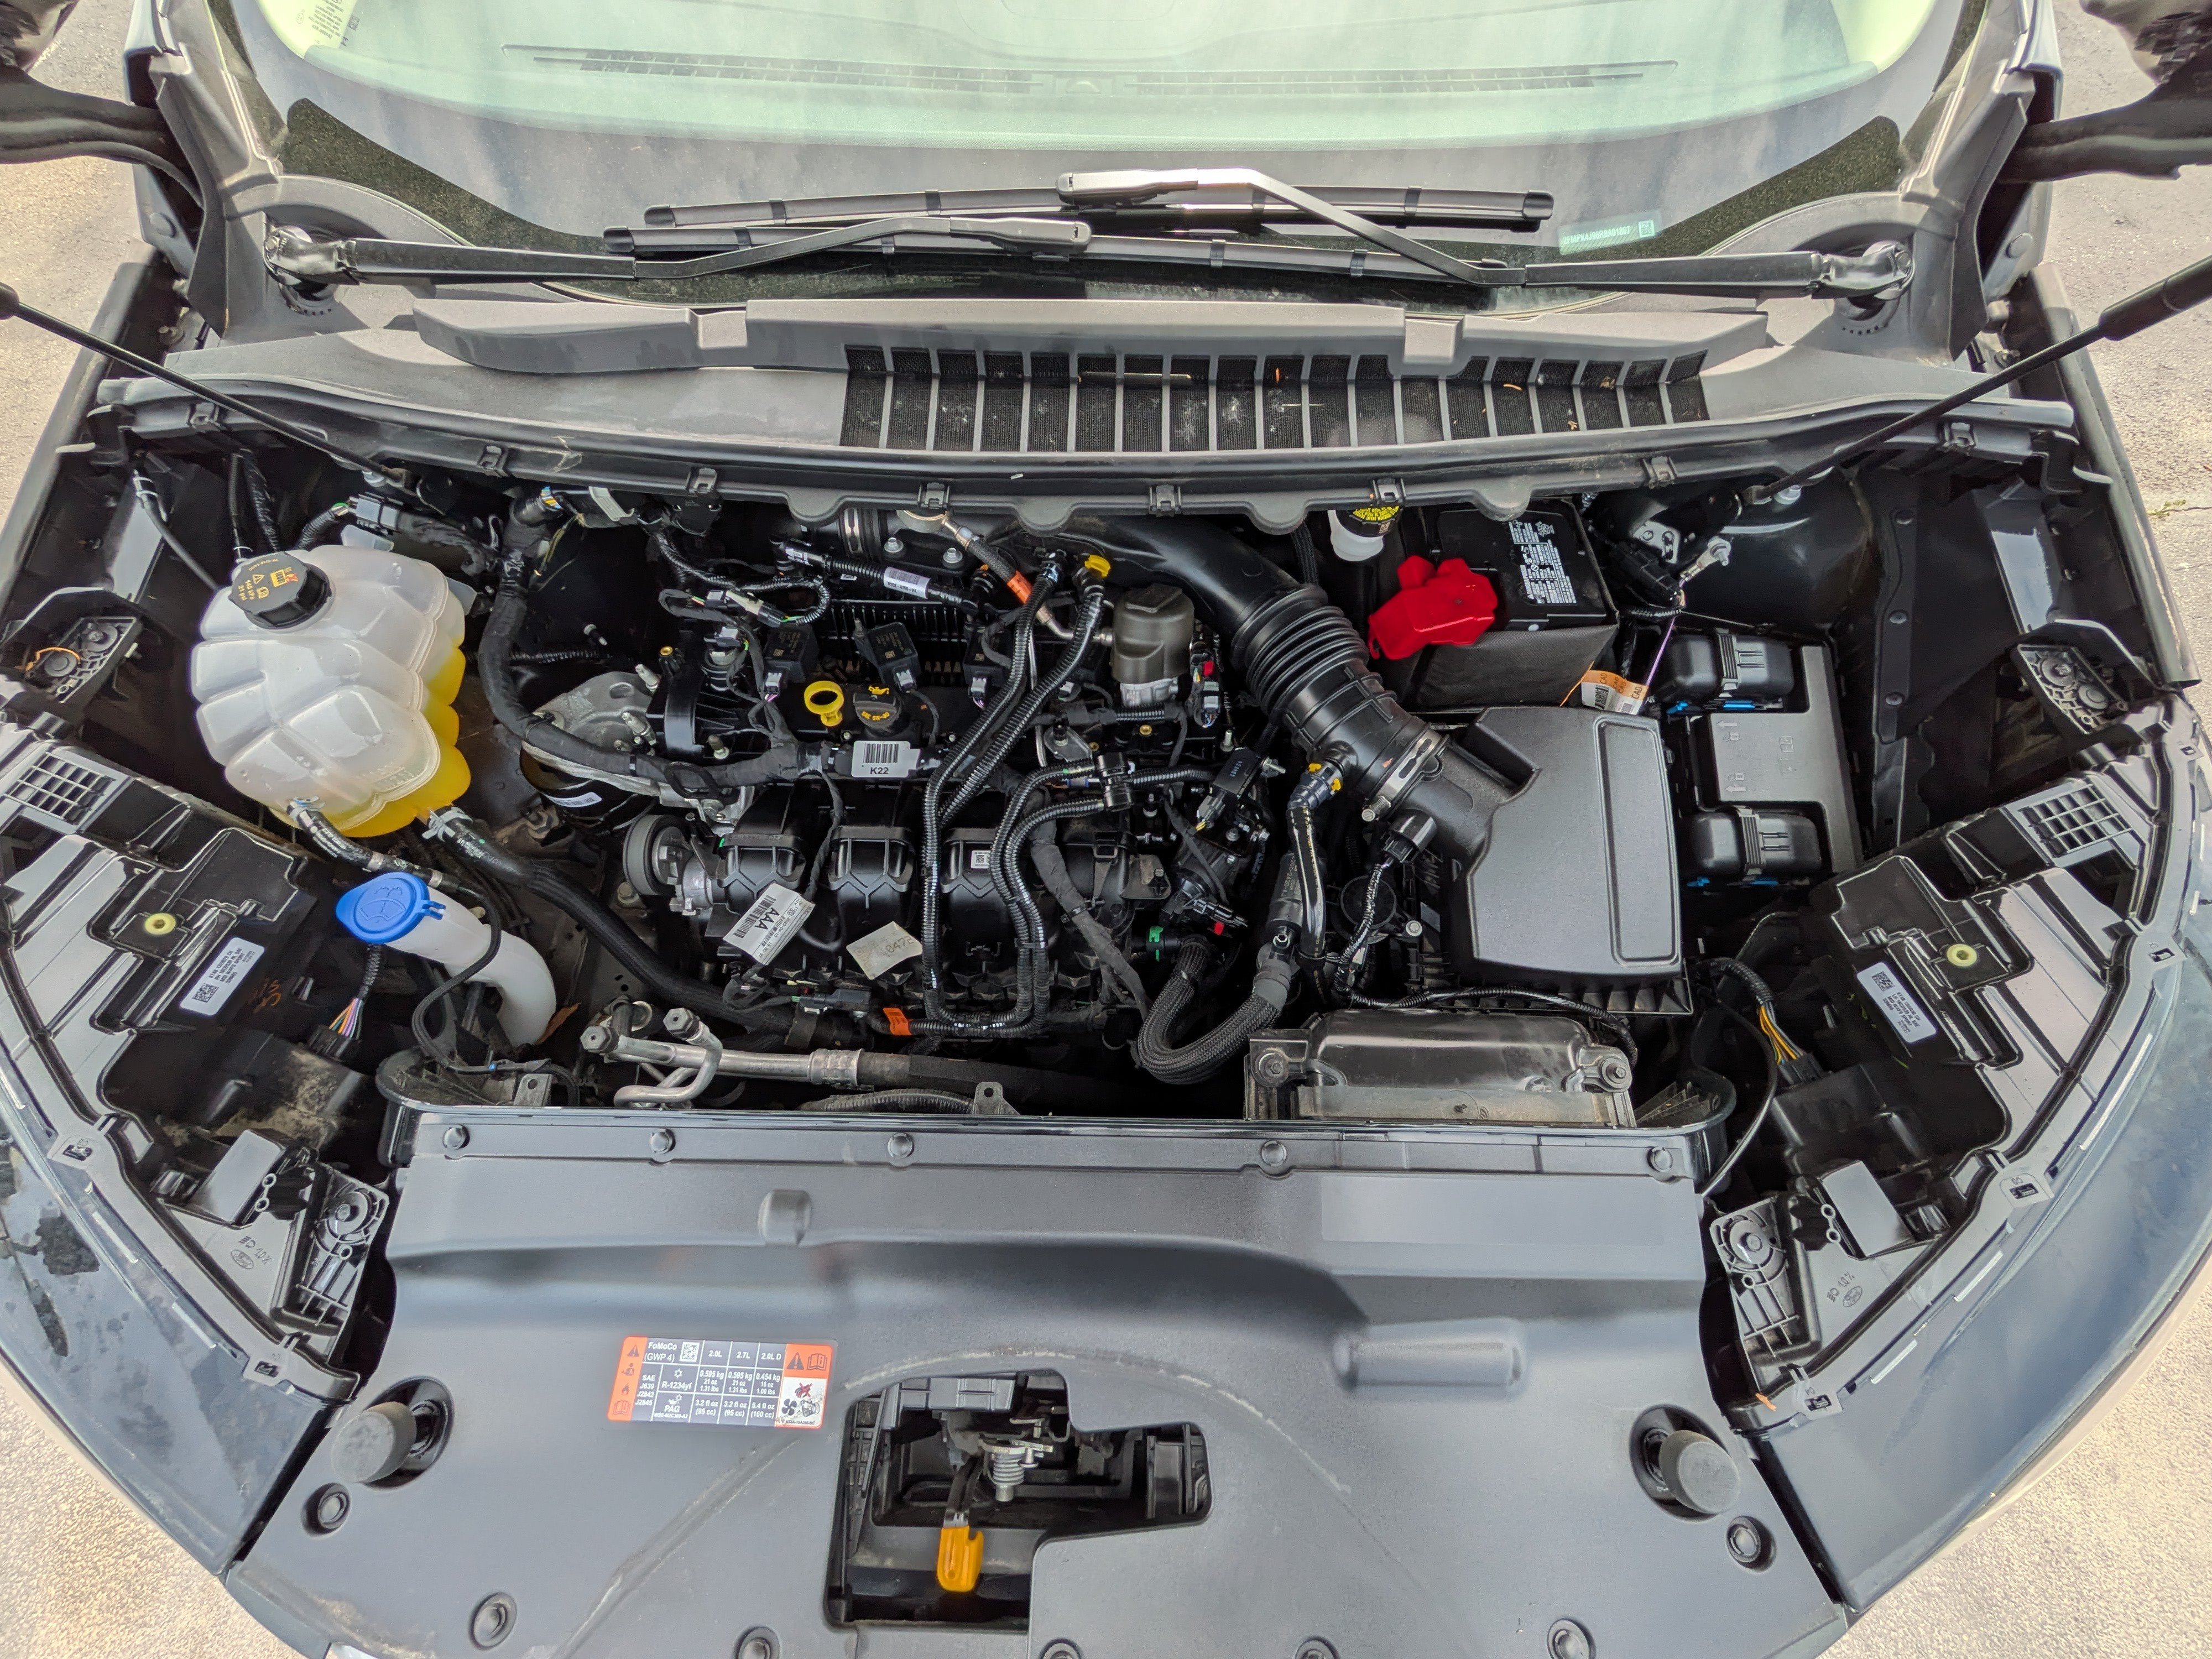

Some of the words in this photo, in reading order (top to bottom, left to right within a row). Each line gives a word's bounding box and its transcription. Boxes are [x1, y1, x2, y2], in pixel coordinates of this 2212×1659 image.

[1563, 226, 1631, 245] 2FMPK4J96RBA01867
[1618, 681, 1626, 693] CAD
[1632, 686, 1643, 699] CAD
[861, 711, 871, 719] SAE
[754, 906, 780, 935] AAA
[667, 1354, 675, 1363] 4)
[745, 1373, 752, 1381] kg
[773, 1374, 780, 1382] kg
[662, 1381, 692, 1391] R-1234yf
